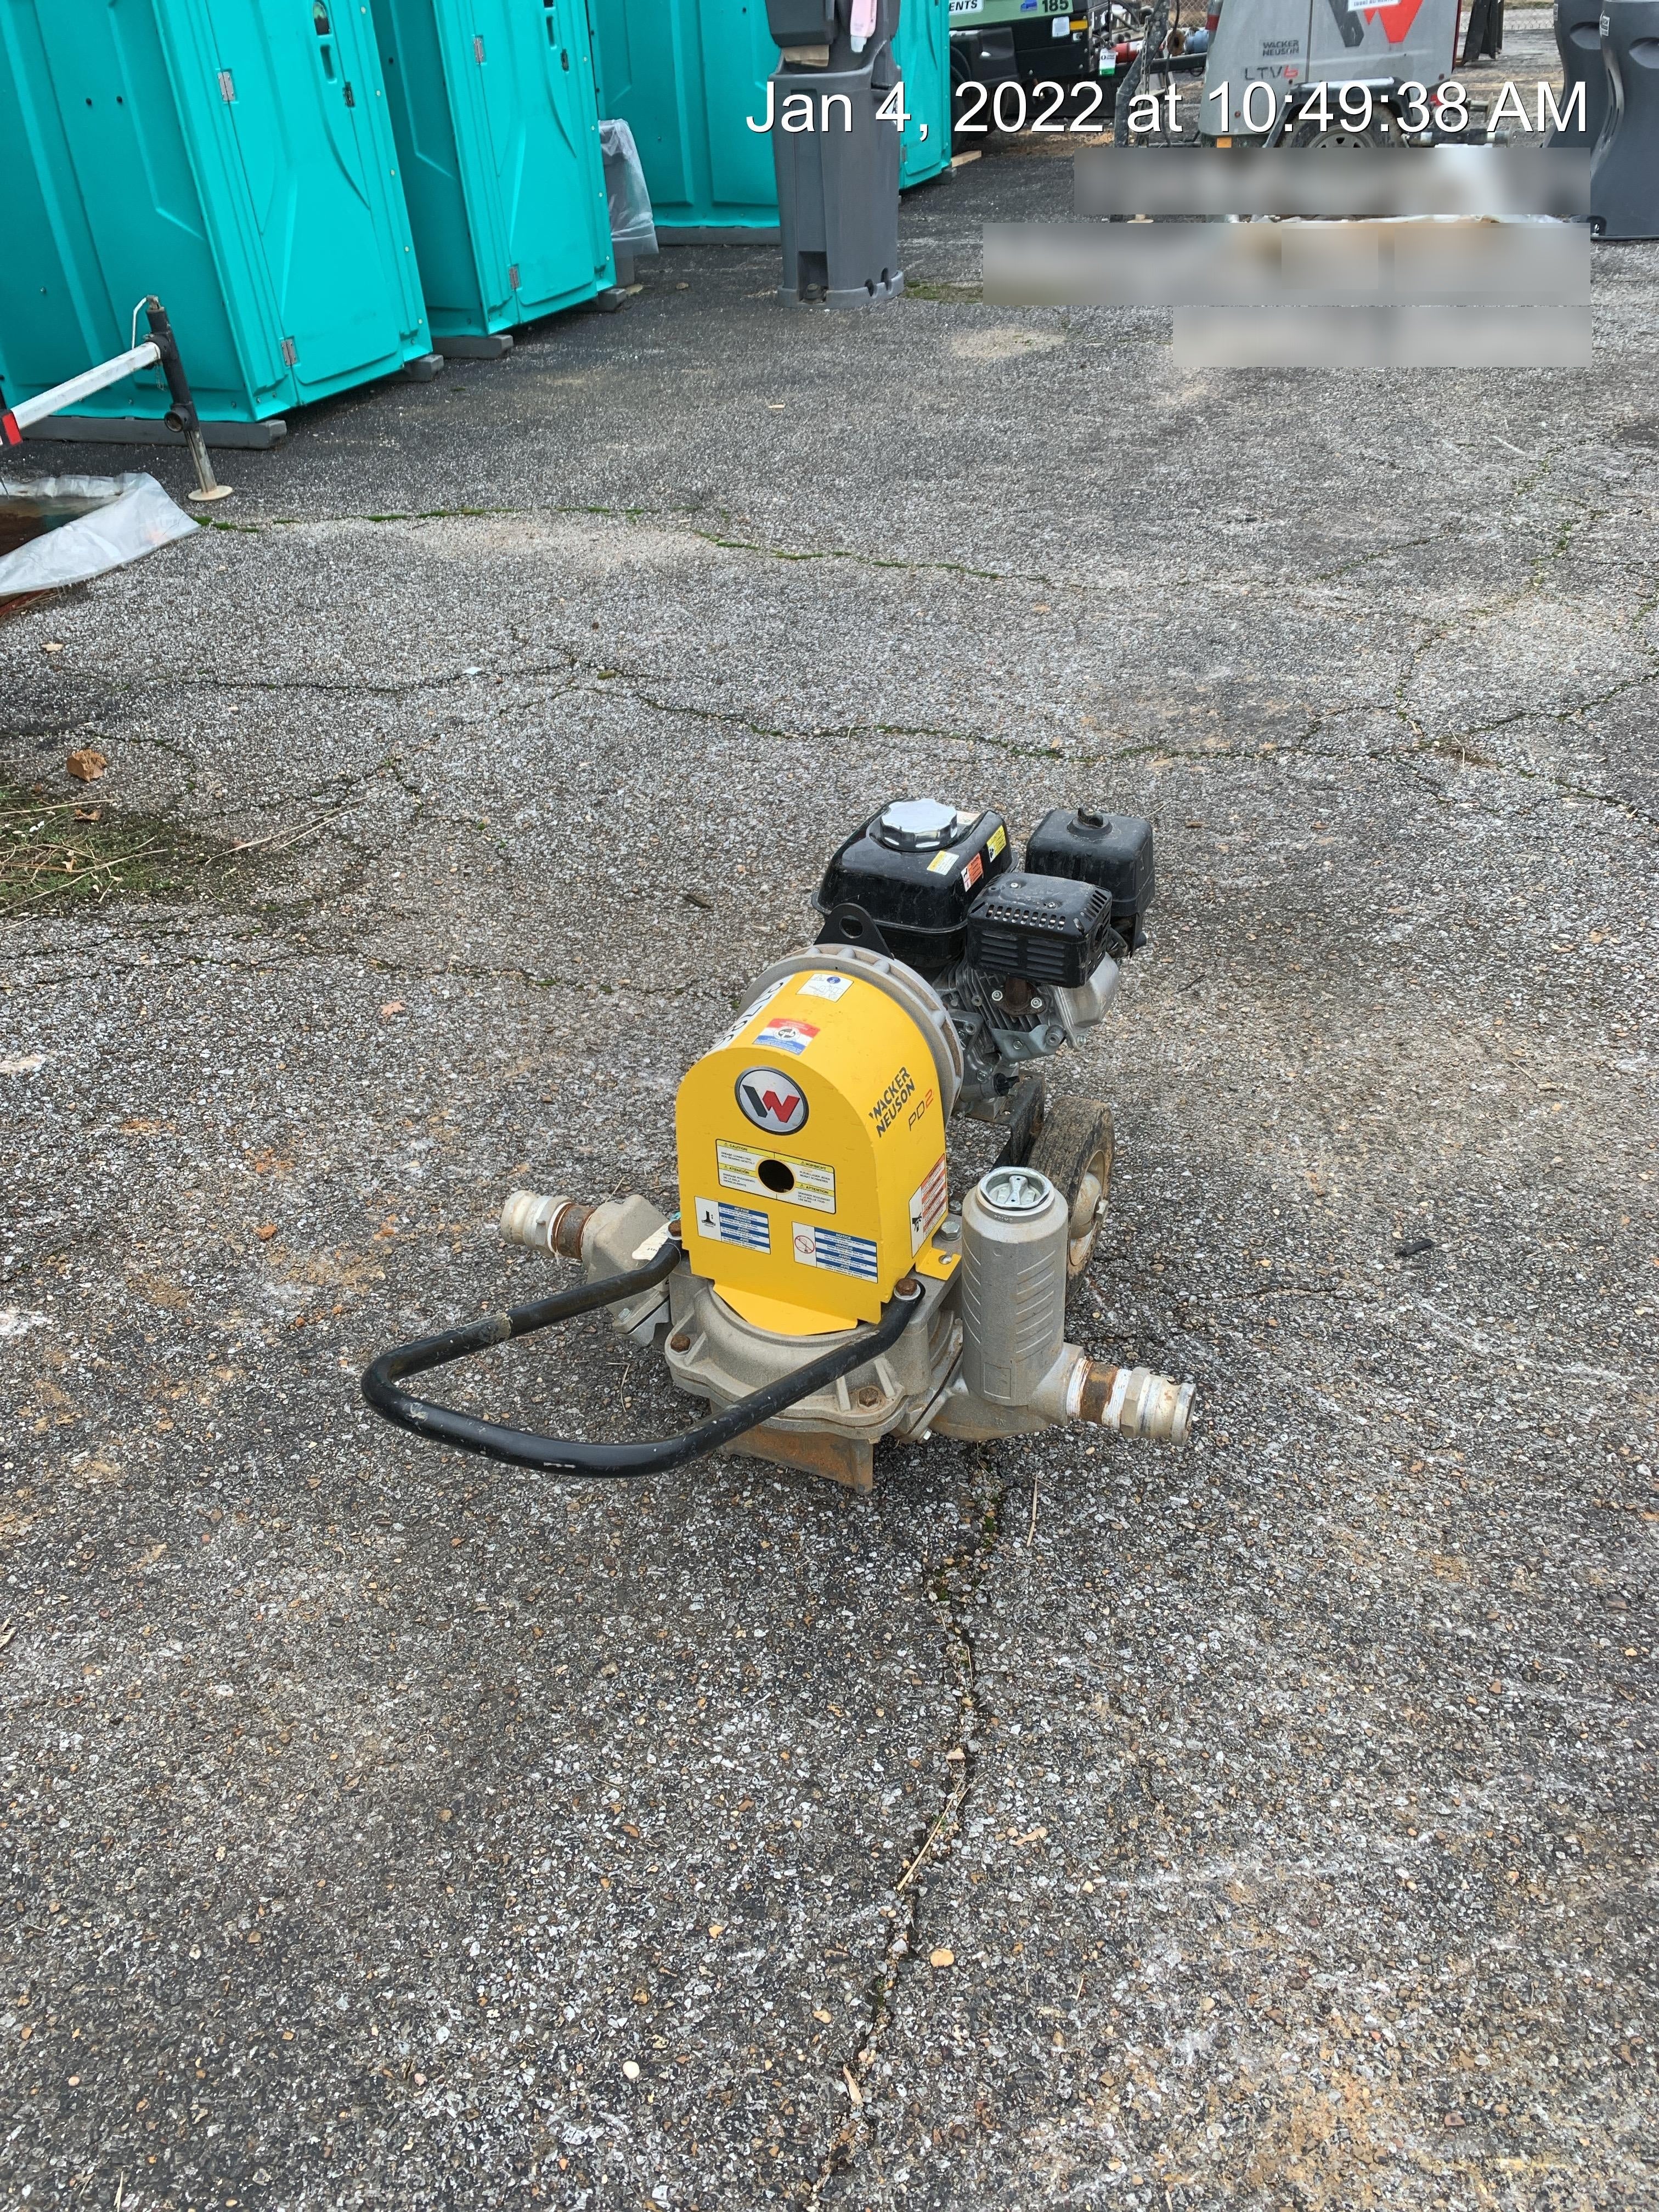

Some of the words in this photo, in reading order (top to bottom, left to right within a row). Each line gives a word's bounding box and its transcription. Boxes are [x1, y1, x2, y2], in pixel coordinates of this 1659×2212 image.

[1042, 0, 1069, 13] 185
[1263, 40, 1299, 49] WACKER
[1263, 47, 1299, 57] NEUSON
[1245, 65, 1299, 81] LTV6
[868, 1066, 911, 1121] WACKER
[876, 1077, 915, 1138] NEUSON
[909, 1088, 934, 1132] PD2
[805, 1185, 829, 1194] ATTENTION
